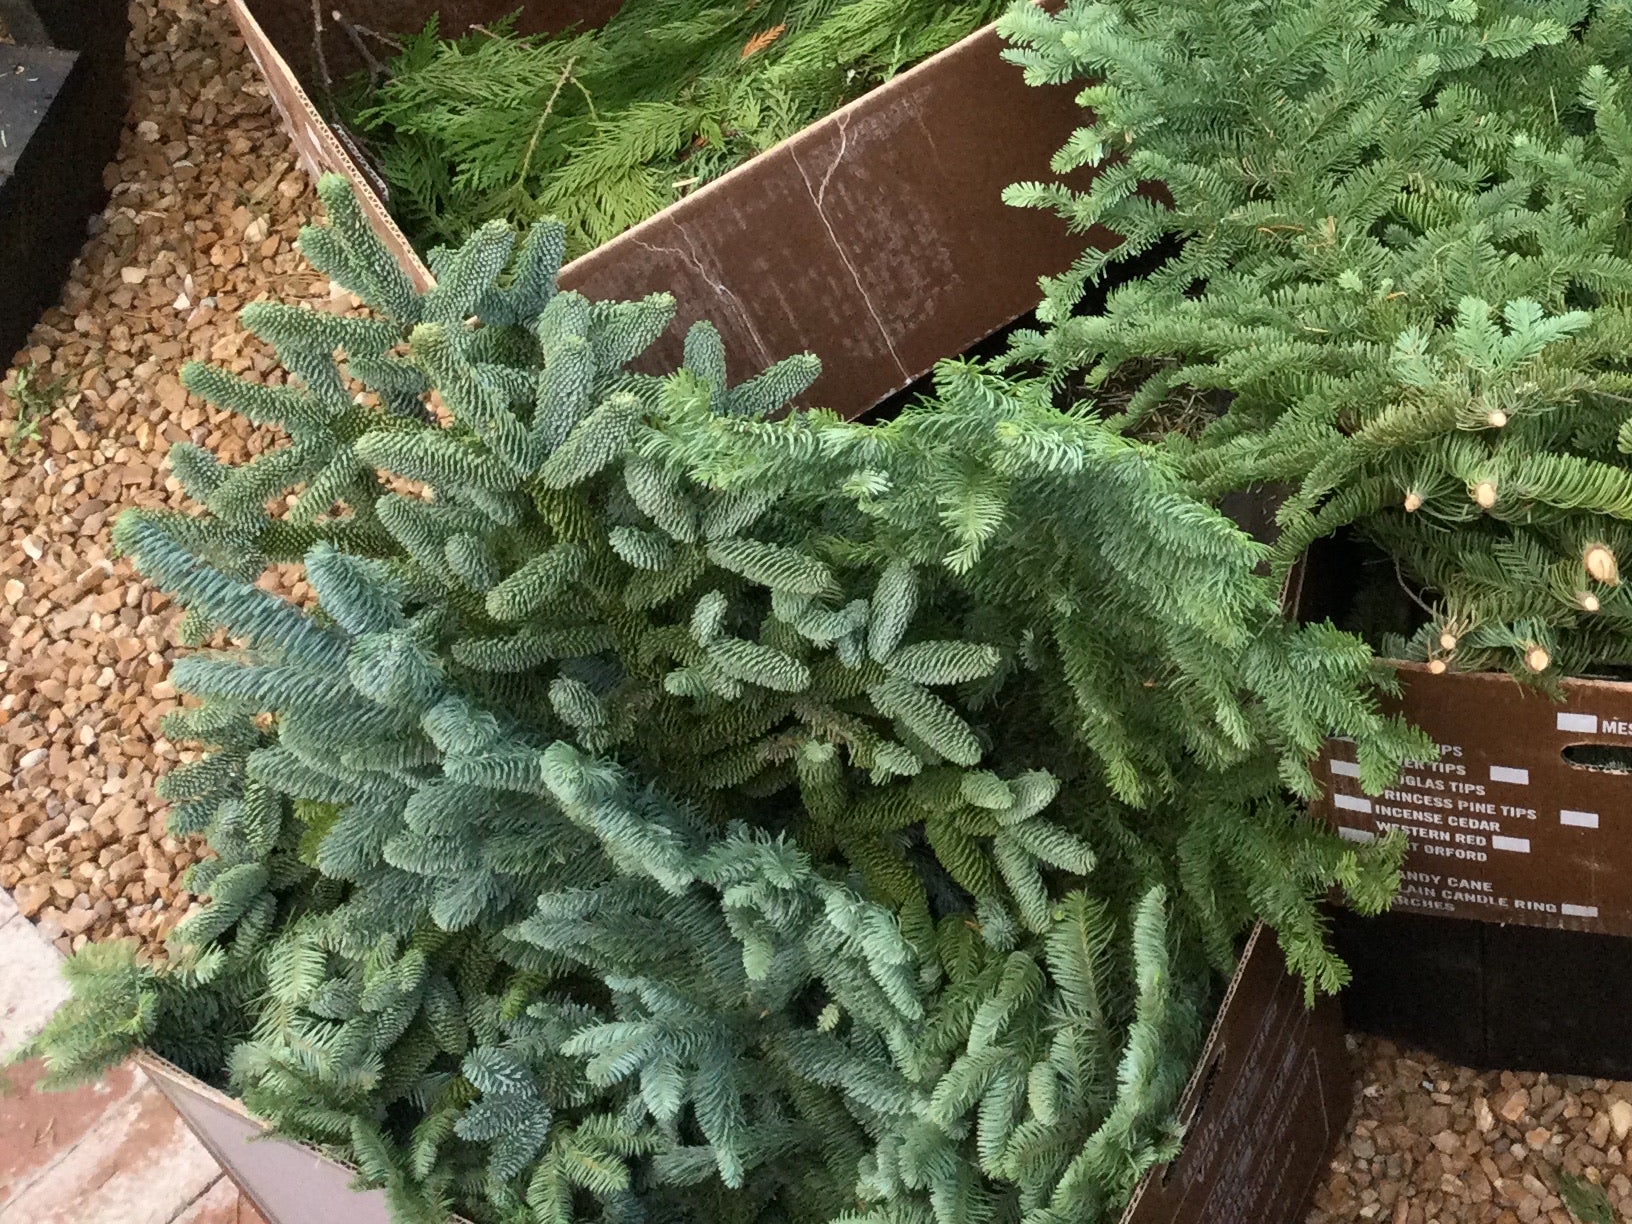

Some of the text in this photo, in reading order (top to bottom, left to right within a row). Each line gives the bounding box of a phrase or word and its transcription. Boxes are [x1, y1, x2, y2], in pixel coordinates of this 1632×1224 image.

[1431, 762, 1466, 776] TIPS
[1400, 775, 1486, 796] GLAS TIPS
[1384, 789, 1537, 820] RINCESS PINE TIPS
[1375, 804, 1500, 832] INCENSE CEDAR
[1455, 833, 1487, 847] RED
[1424, 844, 1488, 862] ORFORD
[1398, 870, 1493, 892] ANDY CANE
[1398, 884, 1558, 913] LAIN CANDLE RING
